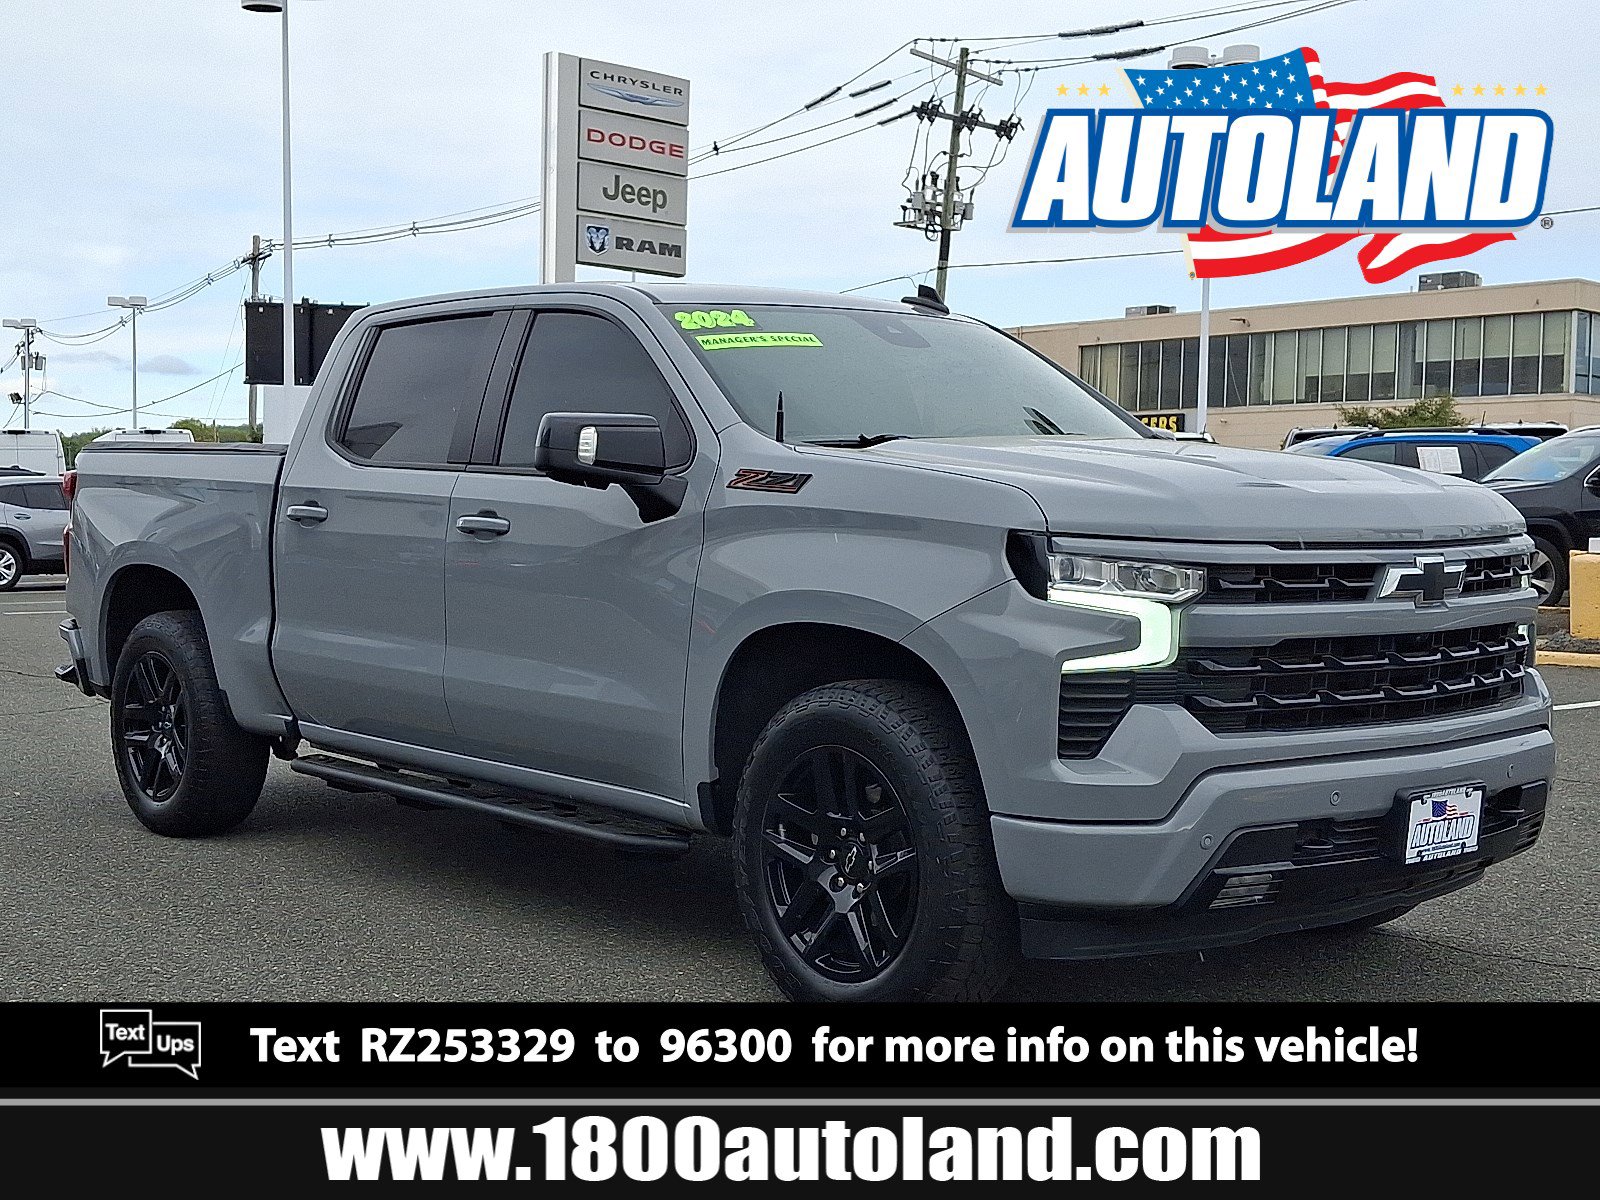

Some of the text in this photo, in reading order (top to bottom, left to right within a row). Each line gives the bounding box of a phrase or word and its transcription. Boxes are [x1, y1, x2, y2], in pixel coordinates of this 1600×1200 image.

[590, 70, 683, 96] CHRYSLER
[587, 128, 684, 159] DODGE
[602, 174, 668, 213] Jeep
[615, 236, 682, 258] RAM
[674, 309, 755, 330] 2024
[701, 335, 817, 346] MANAGER'S SPECIAL
[726, 468, 813, 494] Z71
[1410, 815, 1475, 848] AUTOLAND
[1422, 848, 1462, 861] AUTOLAND
